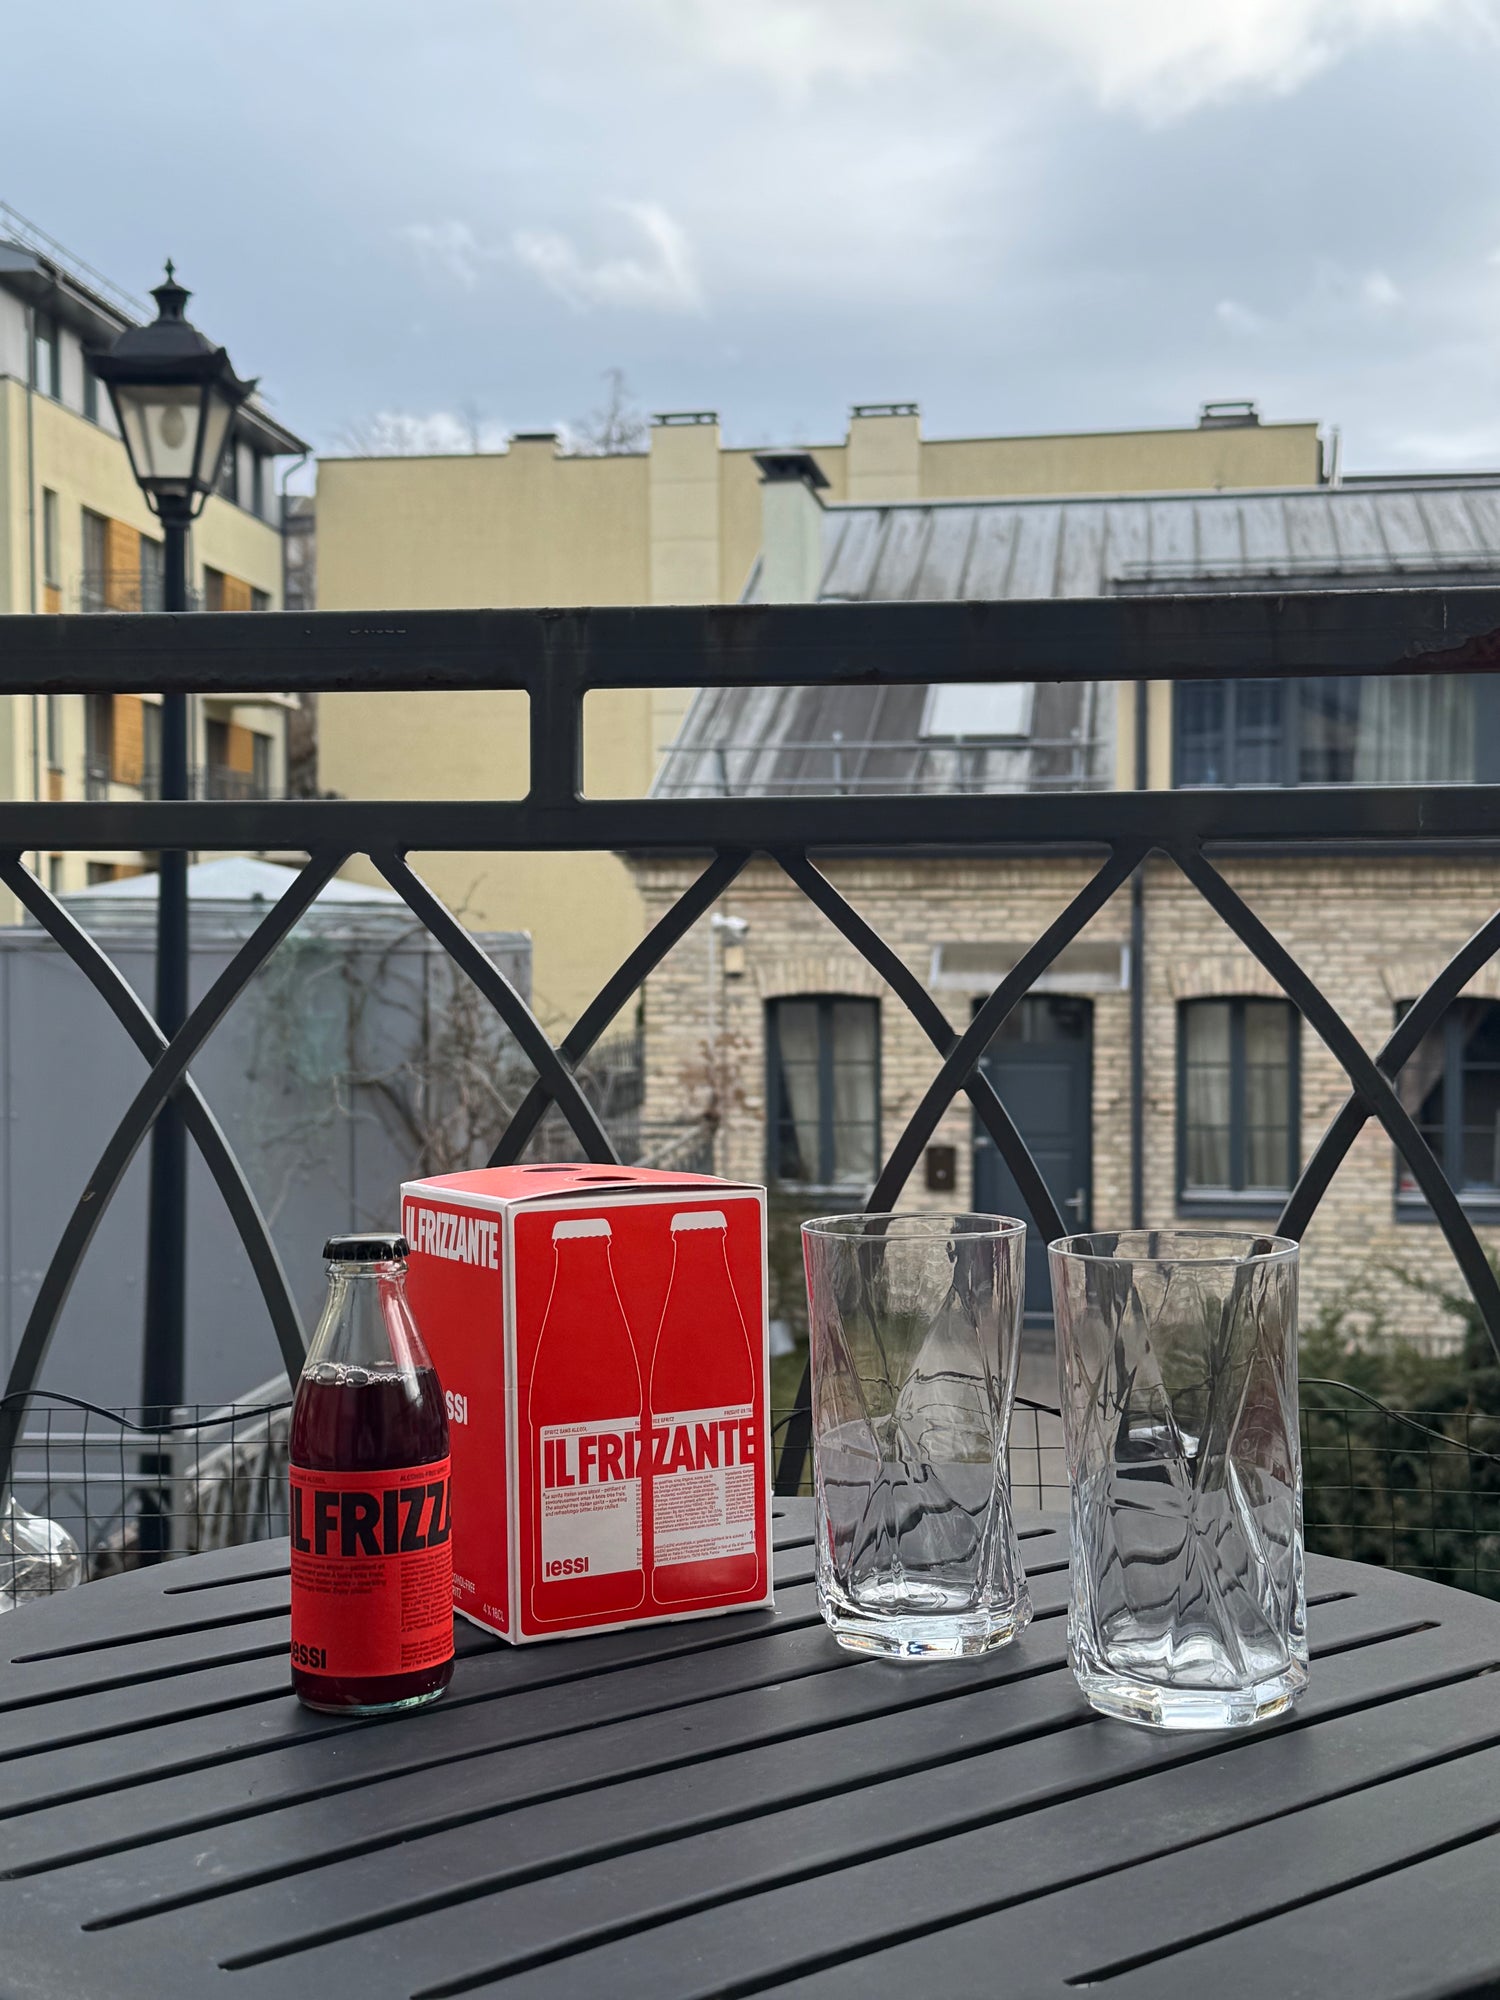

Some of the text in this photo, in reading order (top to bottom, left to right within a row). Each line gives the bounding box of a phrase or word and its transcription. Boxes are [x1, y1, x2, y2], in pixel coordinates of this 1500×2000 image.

[418, 1208, 498, 1270] FRIZZANTE
[544, 1417, 754, 1489] IL FRIZZANTE
